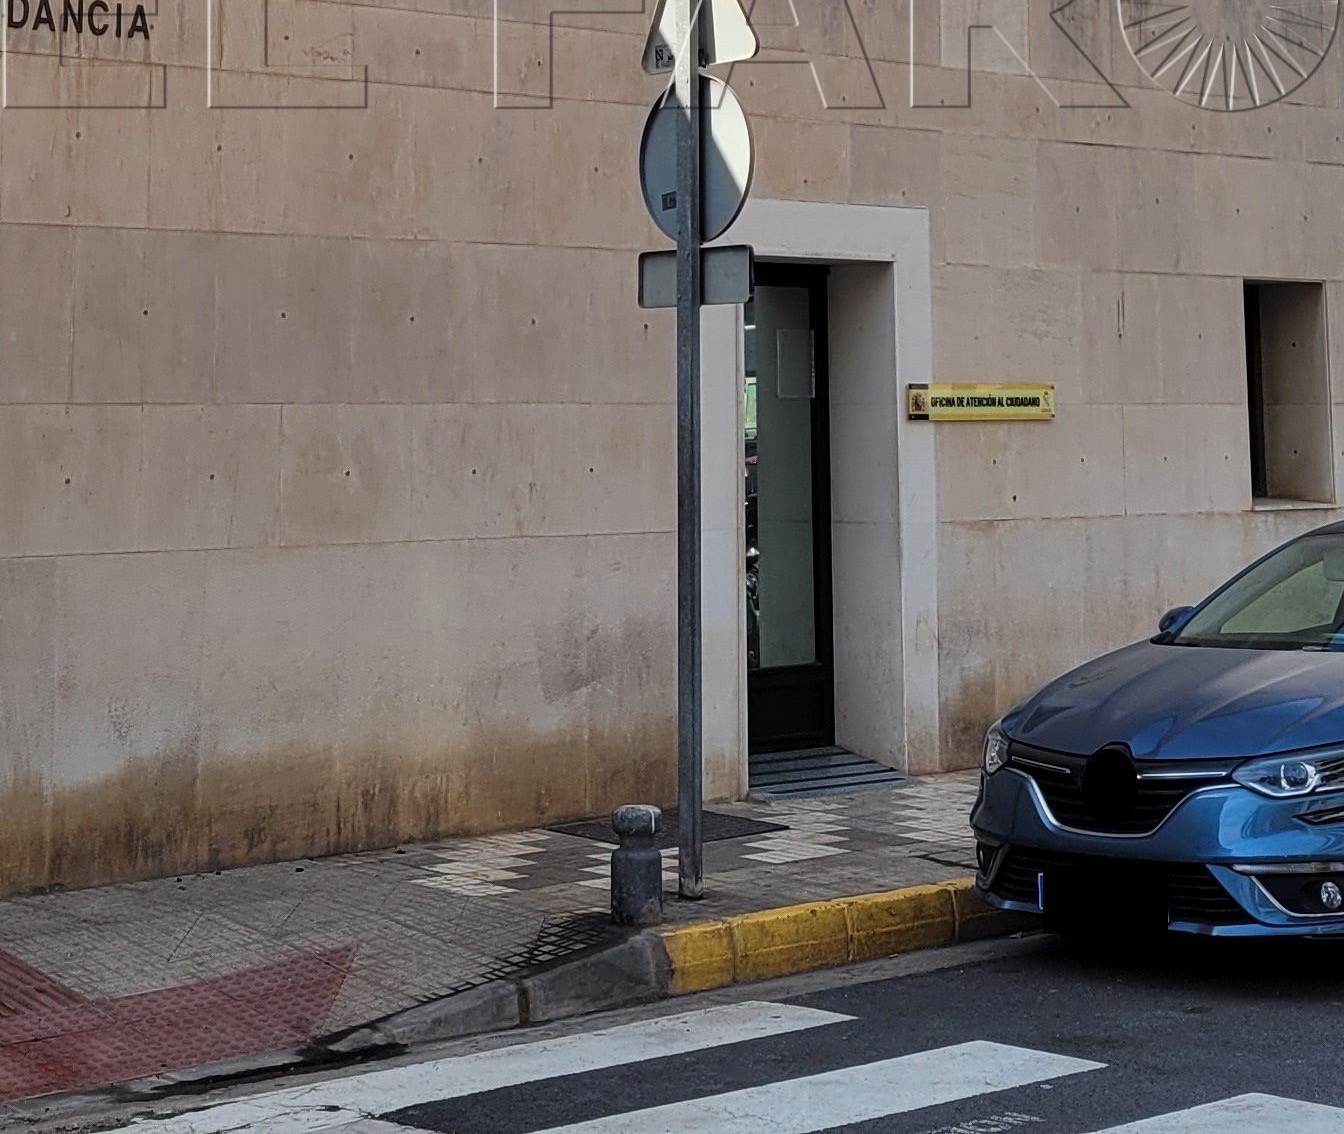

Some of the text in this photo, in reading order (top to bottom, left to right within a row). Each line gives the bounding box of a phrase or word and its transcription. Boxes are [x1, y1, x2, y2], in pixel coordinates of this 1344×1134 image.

[931, 396, 956, 407] OFICINA
[956, 396, 966, 407] DE
[997, 396, 1005, 407] AL
[1006, 396, 1040, 407] CIUDADANO
